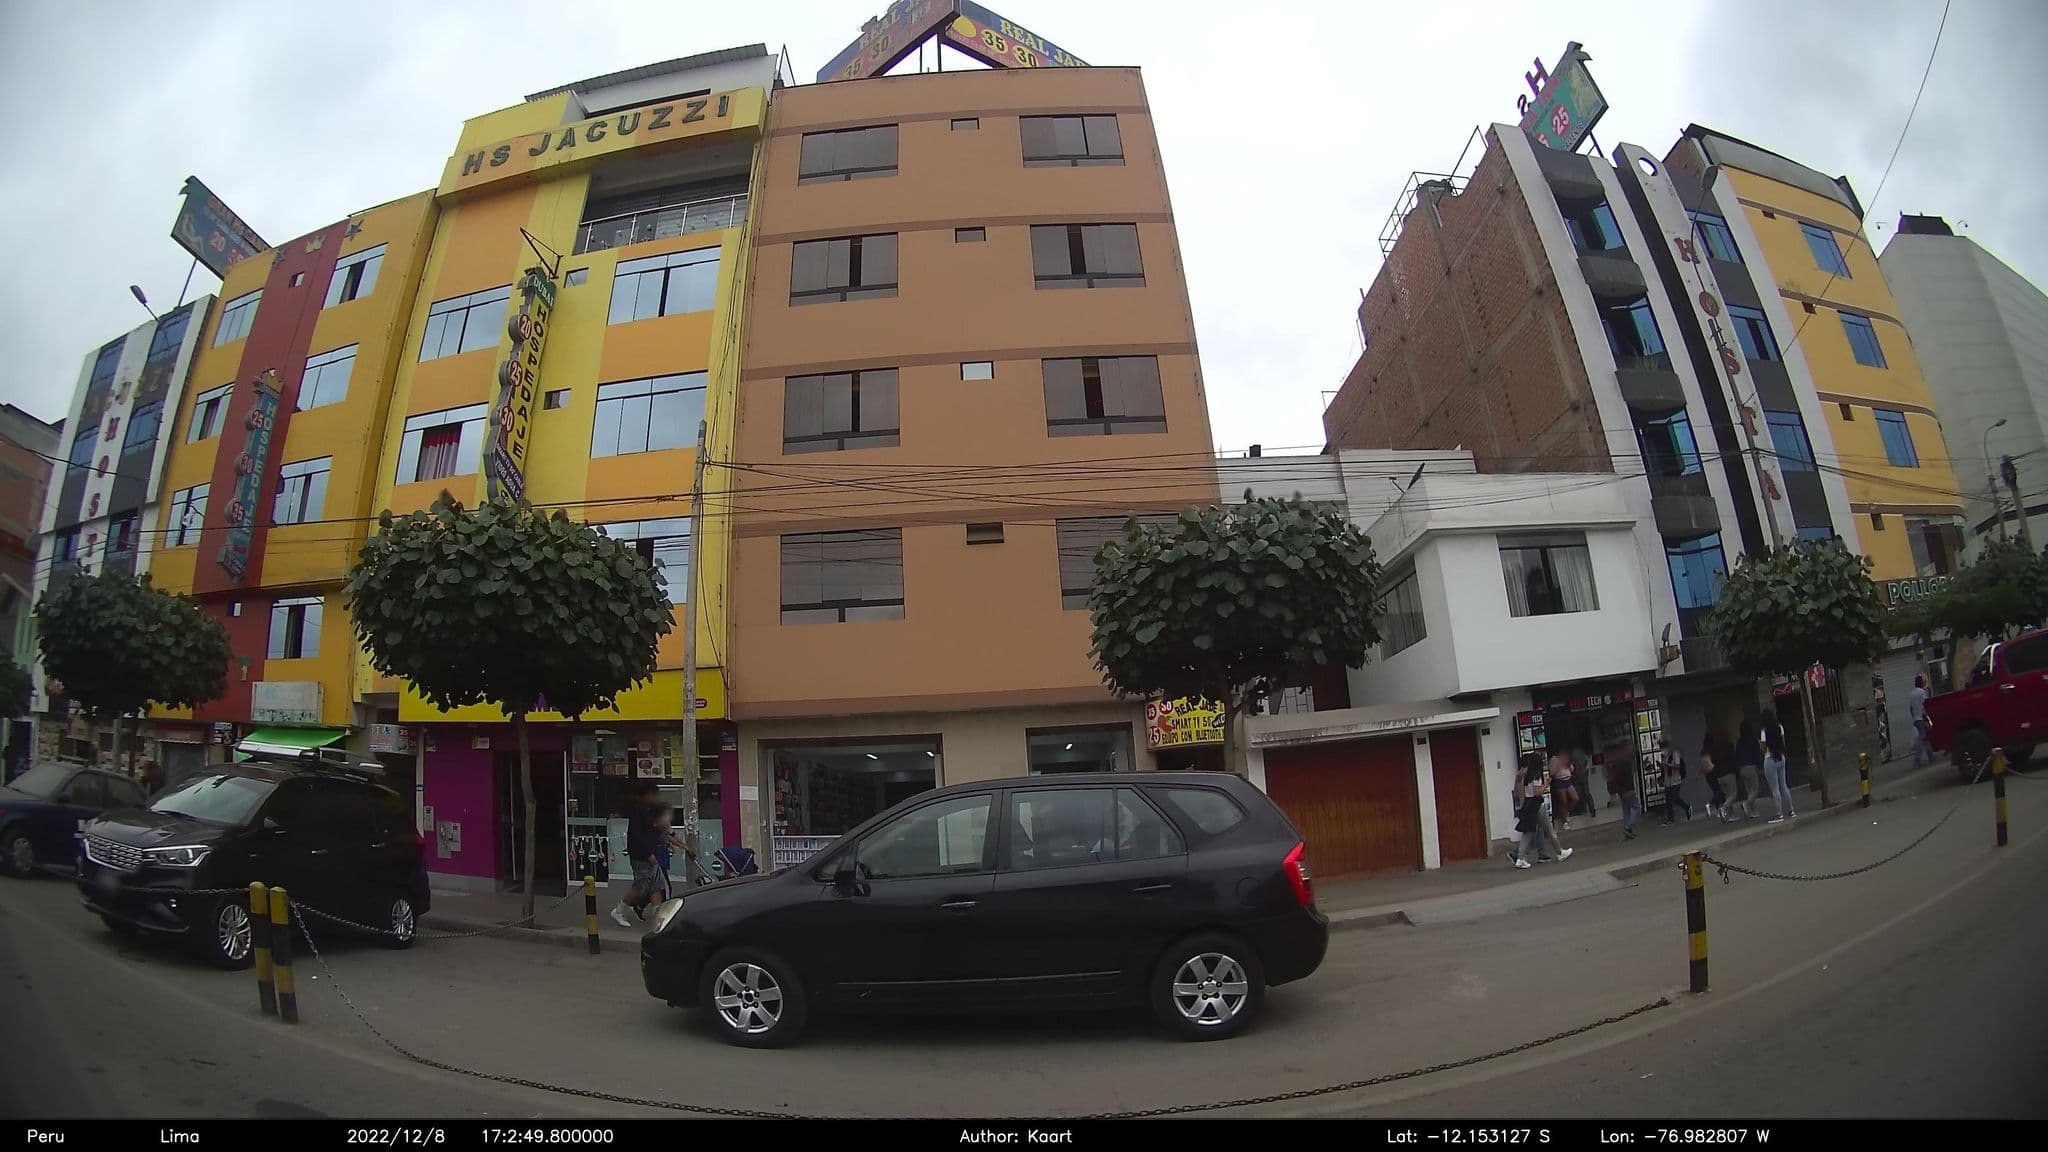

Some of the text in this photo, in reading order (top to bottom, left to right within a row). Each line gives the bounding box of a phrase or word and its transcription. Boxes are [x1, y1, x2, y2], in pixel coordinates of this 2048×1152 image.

[984, 30, 1005, 53] 35
[1000, 18, 1049, 56] REAL
[1016, 47, 1037, 67] 30
[1552, 105, 1569, 136] 25
[462, 95, 730, 176] HS JACUZZI
[533, 276, 555, 308] DUBAI
[520, 317, 532, 338] 20
[510, 361, 523, 384] 25
[512, 302, 548, 460] HOSPEDAJE
[251, 409, 264, 428] 25
[502, 408, 515, 432] 30
[240, 459, 254, 476] 30
[242, 402, 277, 533] HOSPEDAJE
[232, 502, 245, 521] 35
[1586, 696, 1602, 706] TECH
[1149, 727, 1160, 742] 25
